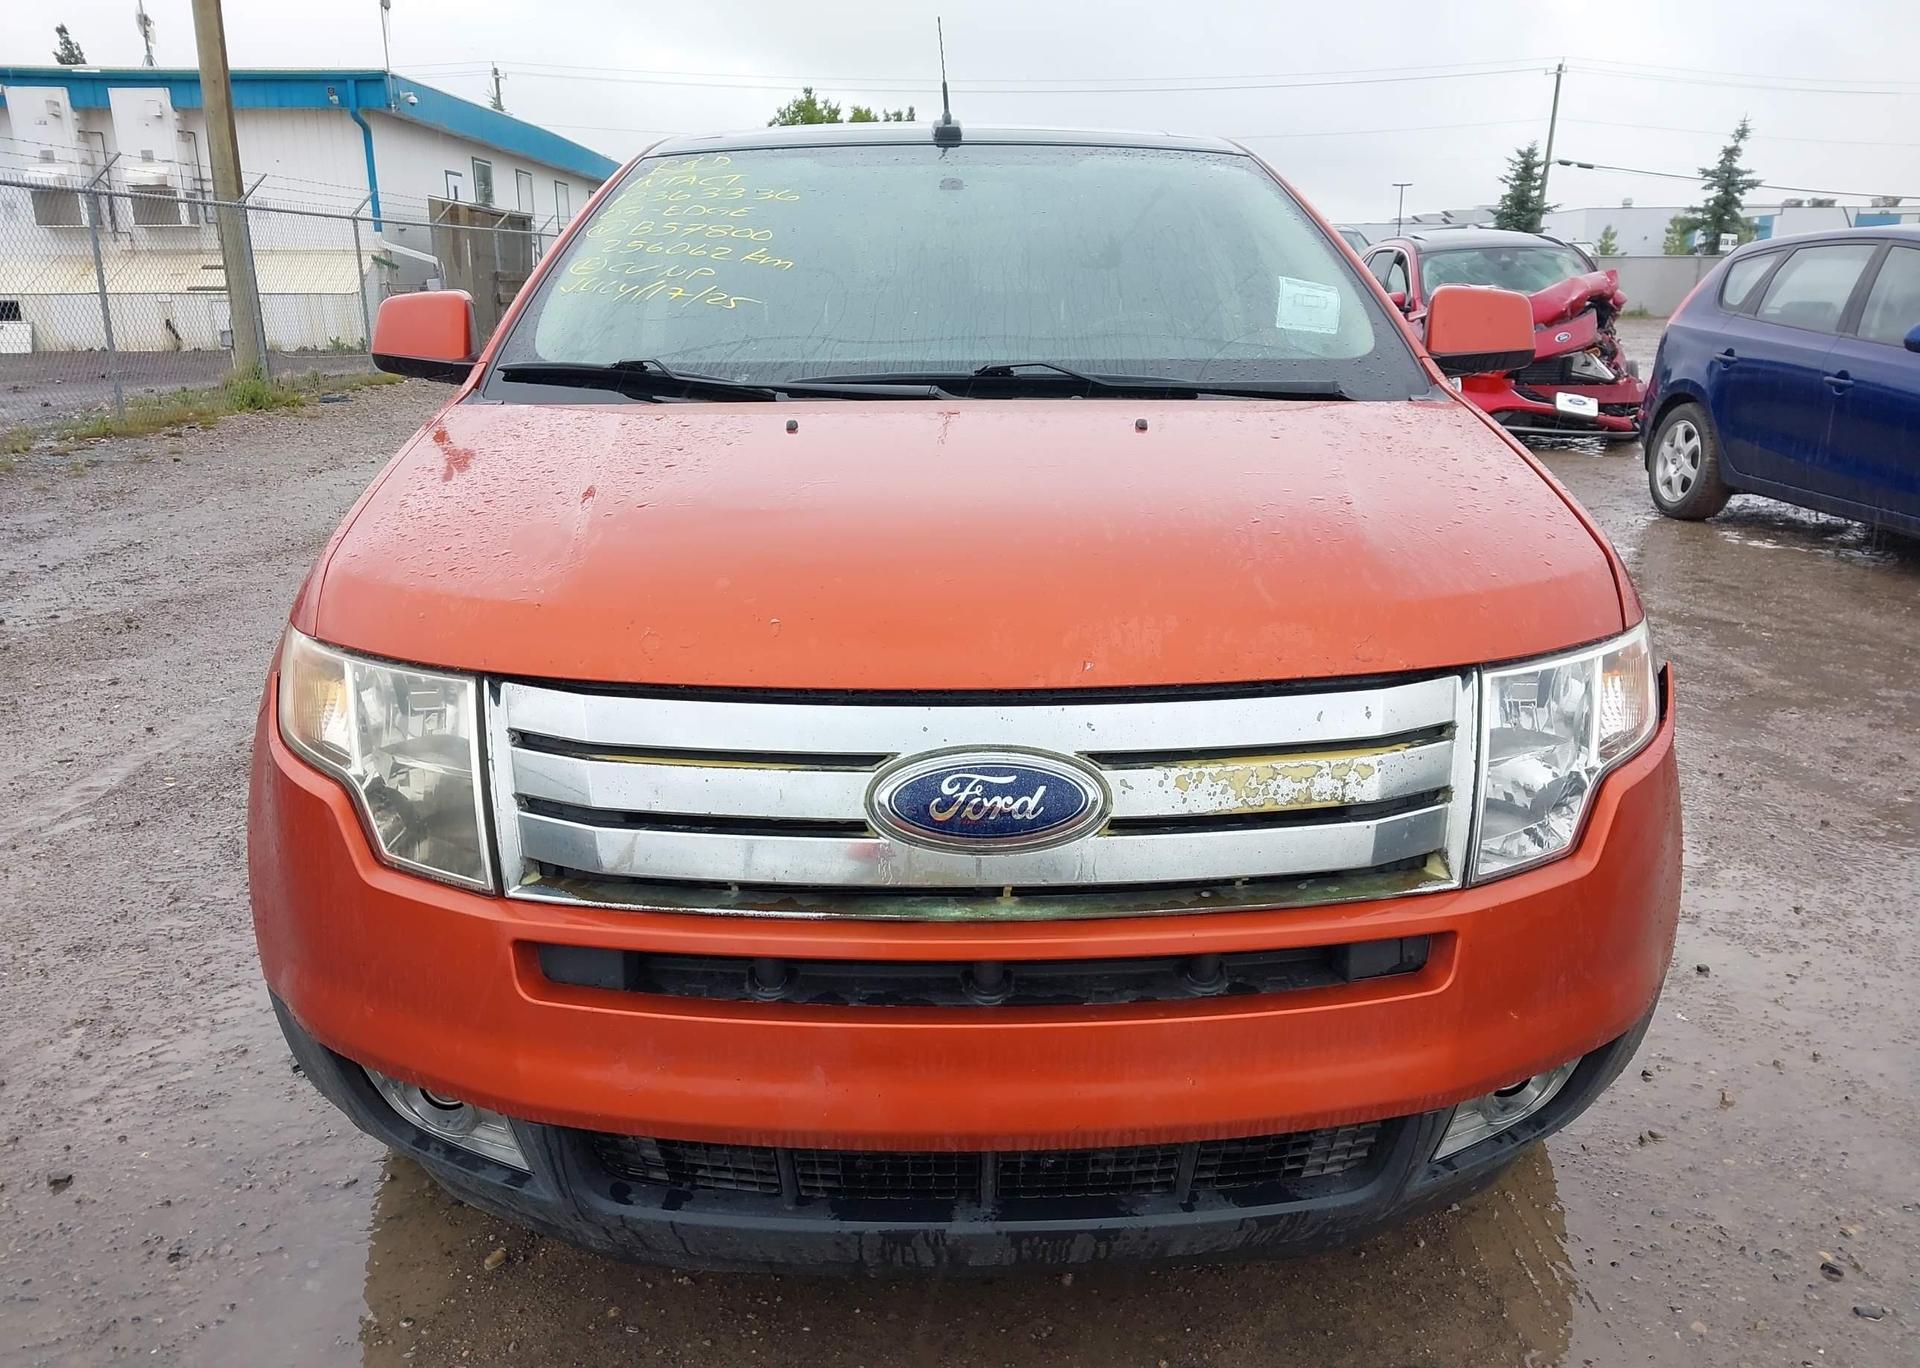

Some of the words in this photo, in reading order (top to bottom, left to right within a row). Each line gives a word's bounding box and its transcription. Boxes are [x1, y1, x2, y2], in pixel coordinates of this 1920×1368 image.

[602, 239, 735, 261] 256062
[740, 247, 794, 271] km
[929, 774, 1046, 822] Ford
